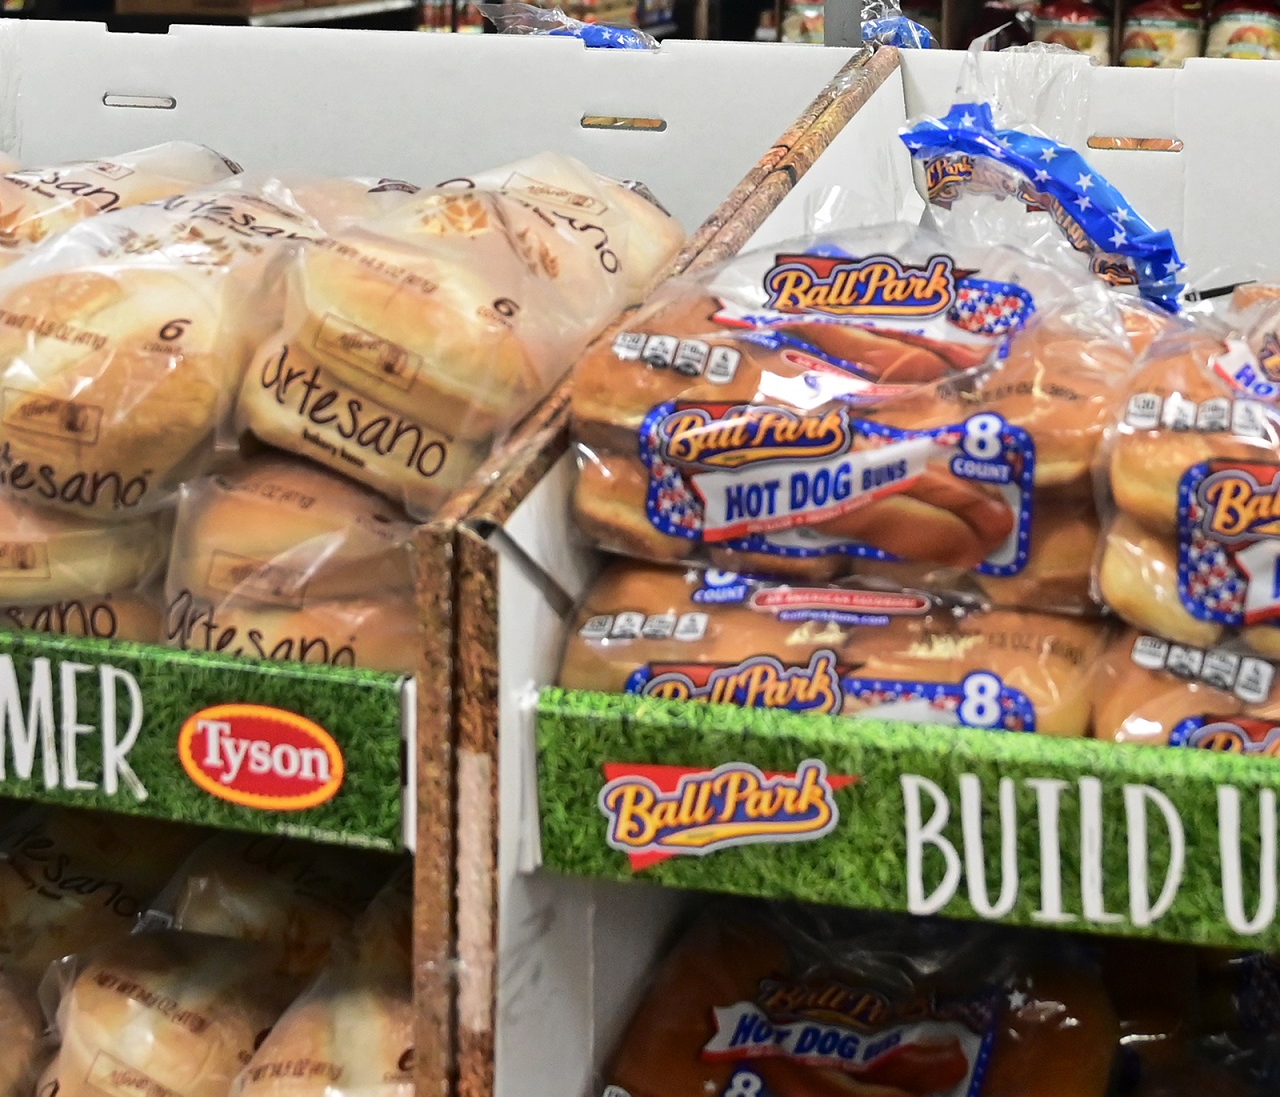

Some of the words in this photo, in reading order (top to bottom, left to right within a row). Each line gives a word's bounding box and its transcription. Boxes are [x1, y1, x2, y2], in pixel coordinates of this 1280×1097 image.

[494, 297, 520, 317] 6
[771, 267, 859, 309] Ball
[858, 262, 951, 302] Park
[159, 319, 192, 341] 6
[664, 412, 752, 458] Ball
[752, 408, 844, 448] Park
[964, 412, 1004, 462] 8
[725, 481, 784, 523] HOT
[790, 462, 852, 510] DOG
[862, 459, 909, 491] BUNS
[952, 457, 1012, 483] COUNT
[735, 658, 832, 713] Park
[962, 672, 1002, 727] 8
[195, 718, 332, 785] Tyson
[607, 782, 714, 848] Ball
[714, 765, 833, 824] Park
[898, 772, 1187, 929] BUILD
[795, 1027, 861, 1061] DOG
